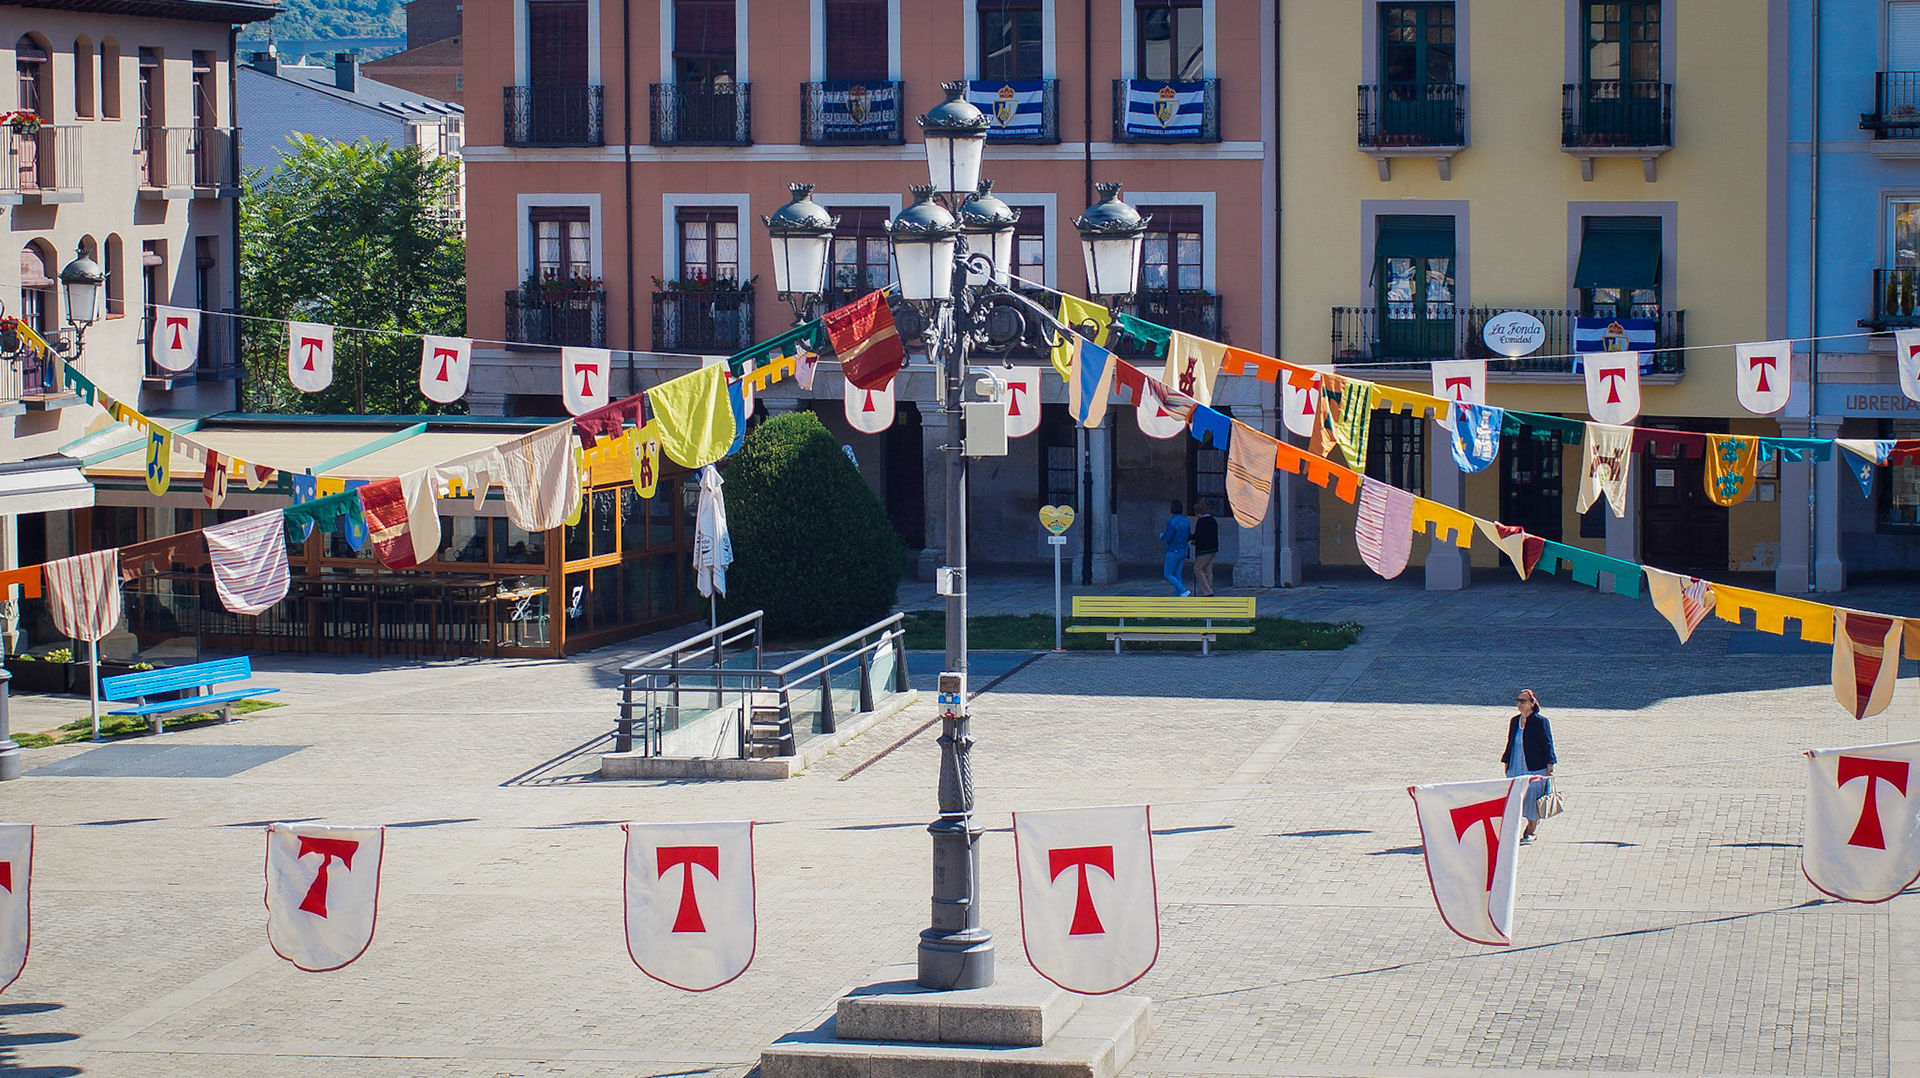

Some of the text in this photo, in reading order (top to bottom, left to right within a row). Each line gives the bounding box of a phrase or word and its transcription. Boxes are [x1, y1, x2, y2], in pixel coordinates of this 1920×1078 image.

[1488, 320, 1541, 336] La Fonda
[1499, 335, 1532, 344] Comidas
[1846, 394, 1920, 411] LIBRERIA
